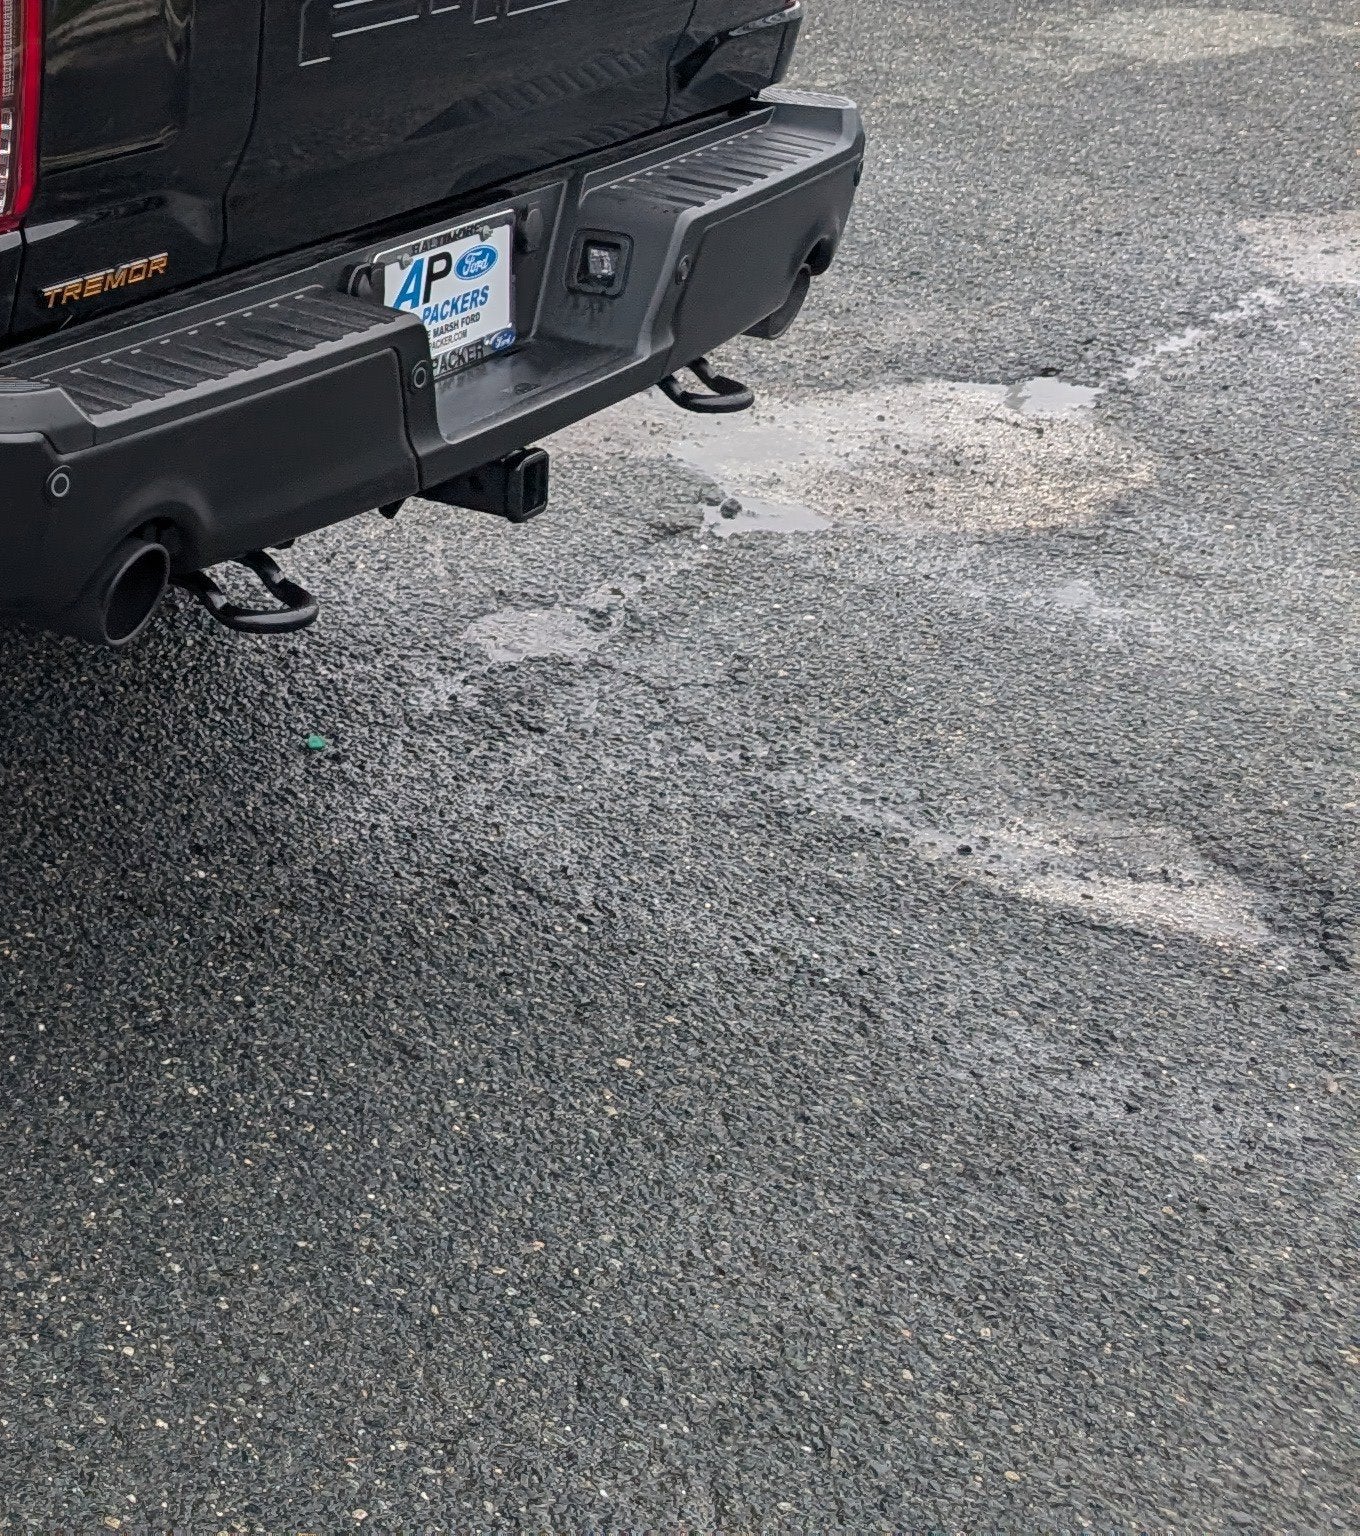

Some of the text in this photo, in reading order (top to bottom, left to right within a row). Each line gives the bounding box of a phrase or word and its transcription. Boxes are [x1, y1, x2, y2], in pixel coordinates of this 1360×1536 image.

[42, 252, 169, 309] TREMOR
[393, 249, 490, 311] AP Ford
[421, 285, 491, 327] PACKERS
[432, 321, 460, 339] MARSH
[460, 312, 481, 330] FORD
